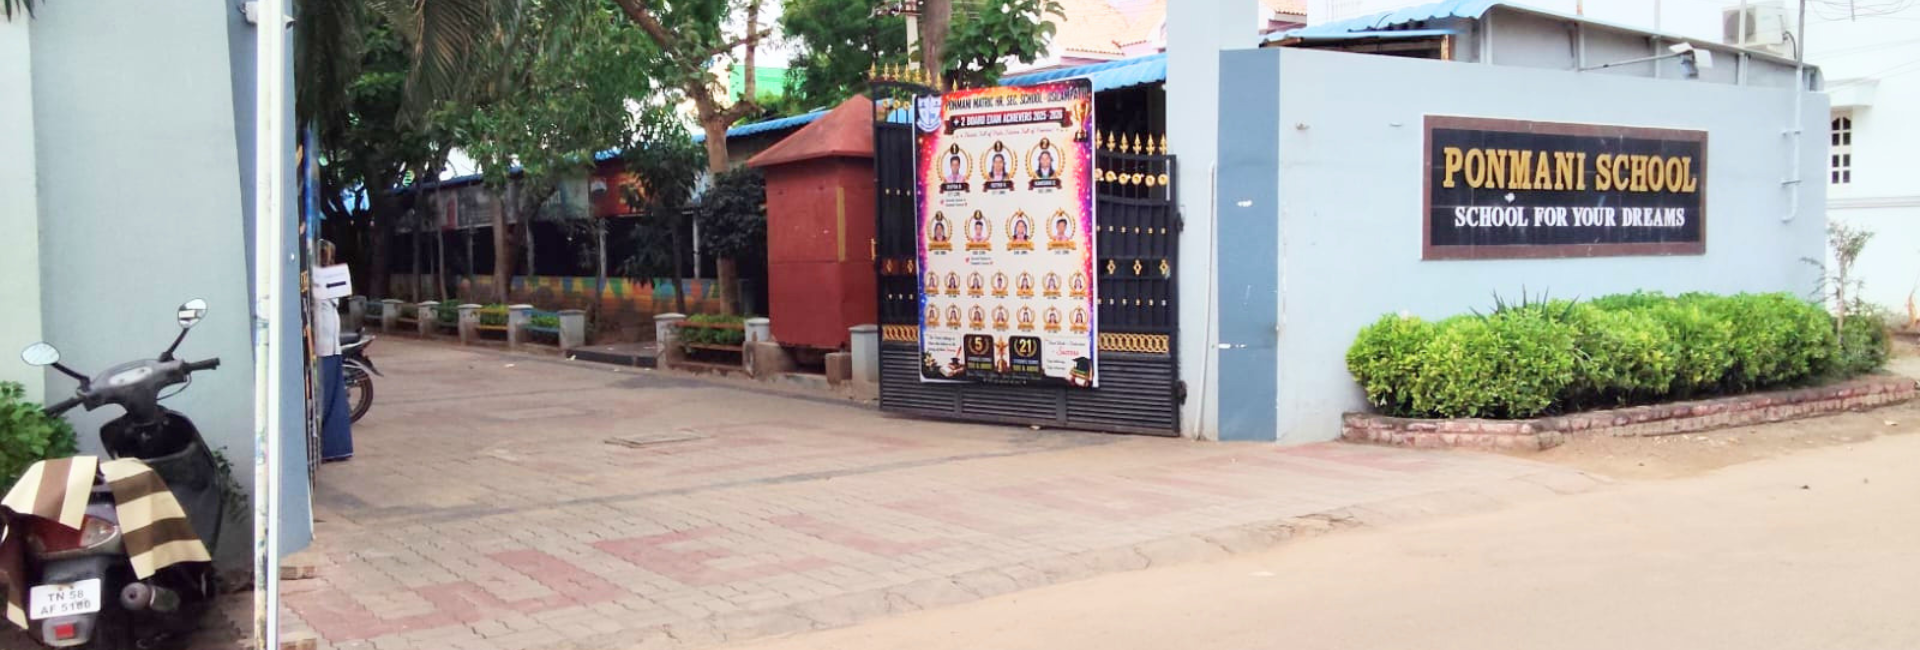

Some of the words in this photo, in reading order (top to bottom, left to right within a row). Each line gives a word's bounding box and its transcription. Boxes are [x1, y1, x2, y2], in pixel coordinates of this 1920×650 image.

[1443, 147, 1586, 190] PONMANI
[1595, 153, 1697, 193] SCHOOL
[1454, 206, 1529, 227] SCHOOL
[1534, 206, 1568, 227] FOR
[1571, 206, 1616, 227] YOUR
[1622, 207, 1685, 227] DREAMS
[975, 337, 983, 351] 5
[1019, 339, 1032, 353] 21
[48, 592, 64, 601] TN
[69, 590, 84, 600] 58
